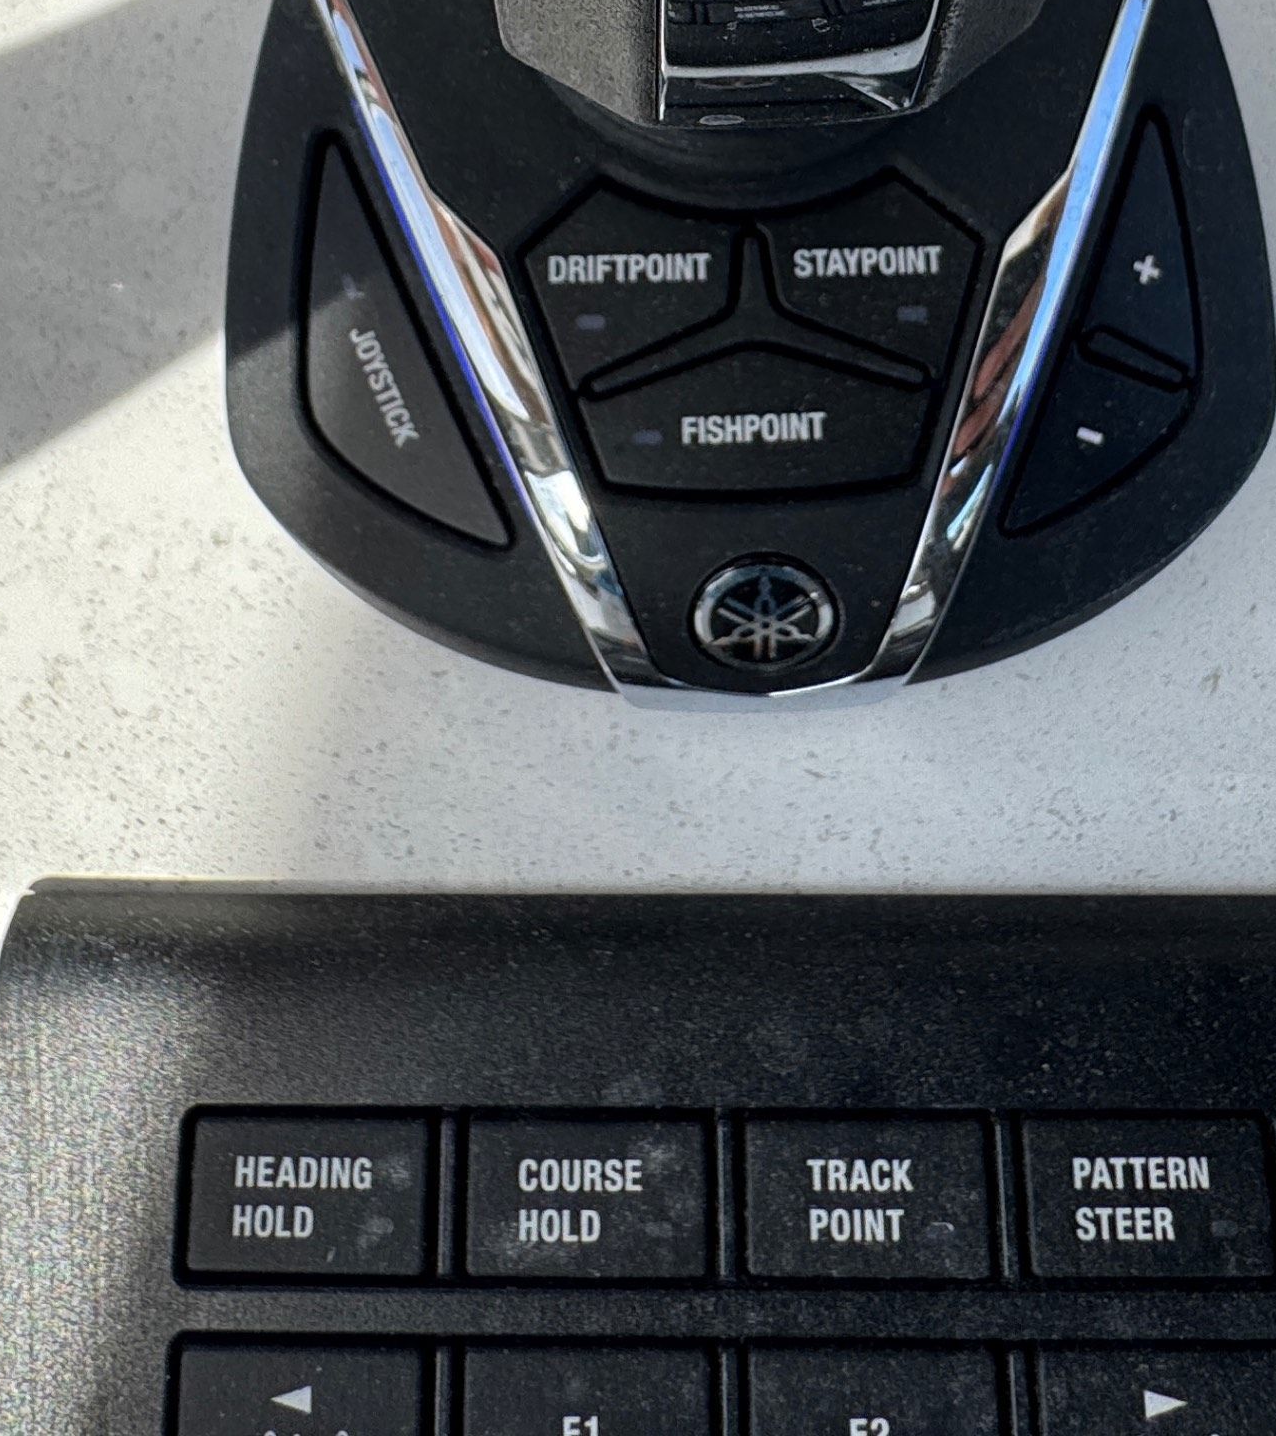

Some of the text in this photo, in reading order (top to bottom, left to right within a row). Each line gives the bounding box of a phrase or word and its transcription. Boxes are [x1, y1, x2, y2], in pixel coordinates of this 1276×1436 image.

[548, 252, 711, 284] DRIFTPOINT
[793, 245, 941, 278] STAYPOINT
[348, 328, 420, 447] JOYSTICK
[681, 411, 826, 445] FISHPOINT
[234, 1155, 372, 1190] HEADING
[518, 1158, 643, 1193] COURSE
[806, 1158, 914, 1192] TRACK
[1072, 1156, 1210, 1190] PATTERN
[232, 1204, 314, 1238] HOLD
[518, 1208, 601, 1243] HOLD
[809, 1208, 905, 1242] POINT
[1075, 1206, 1175, 1241] STEER
